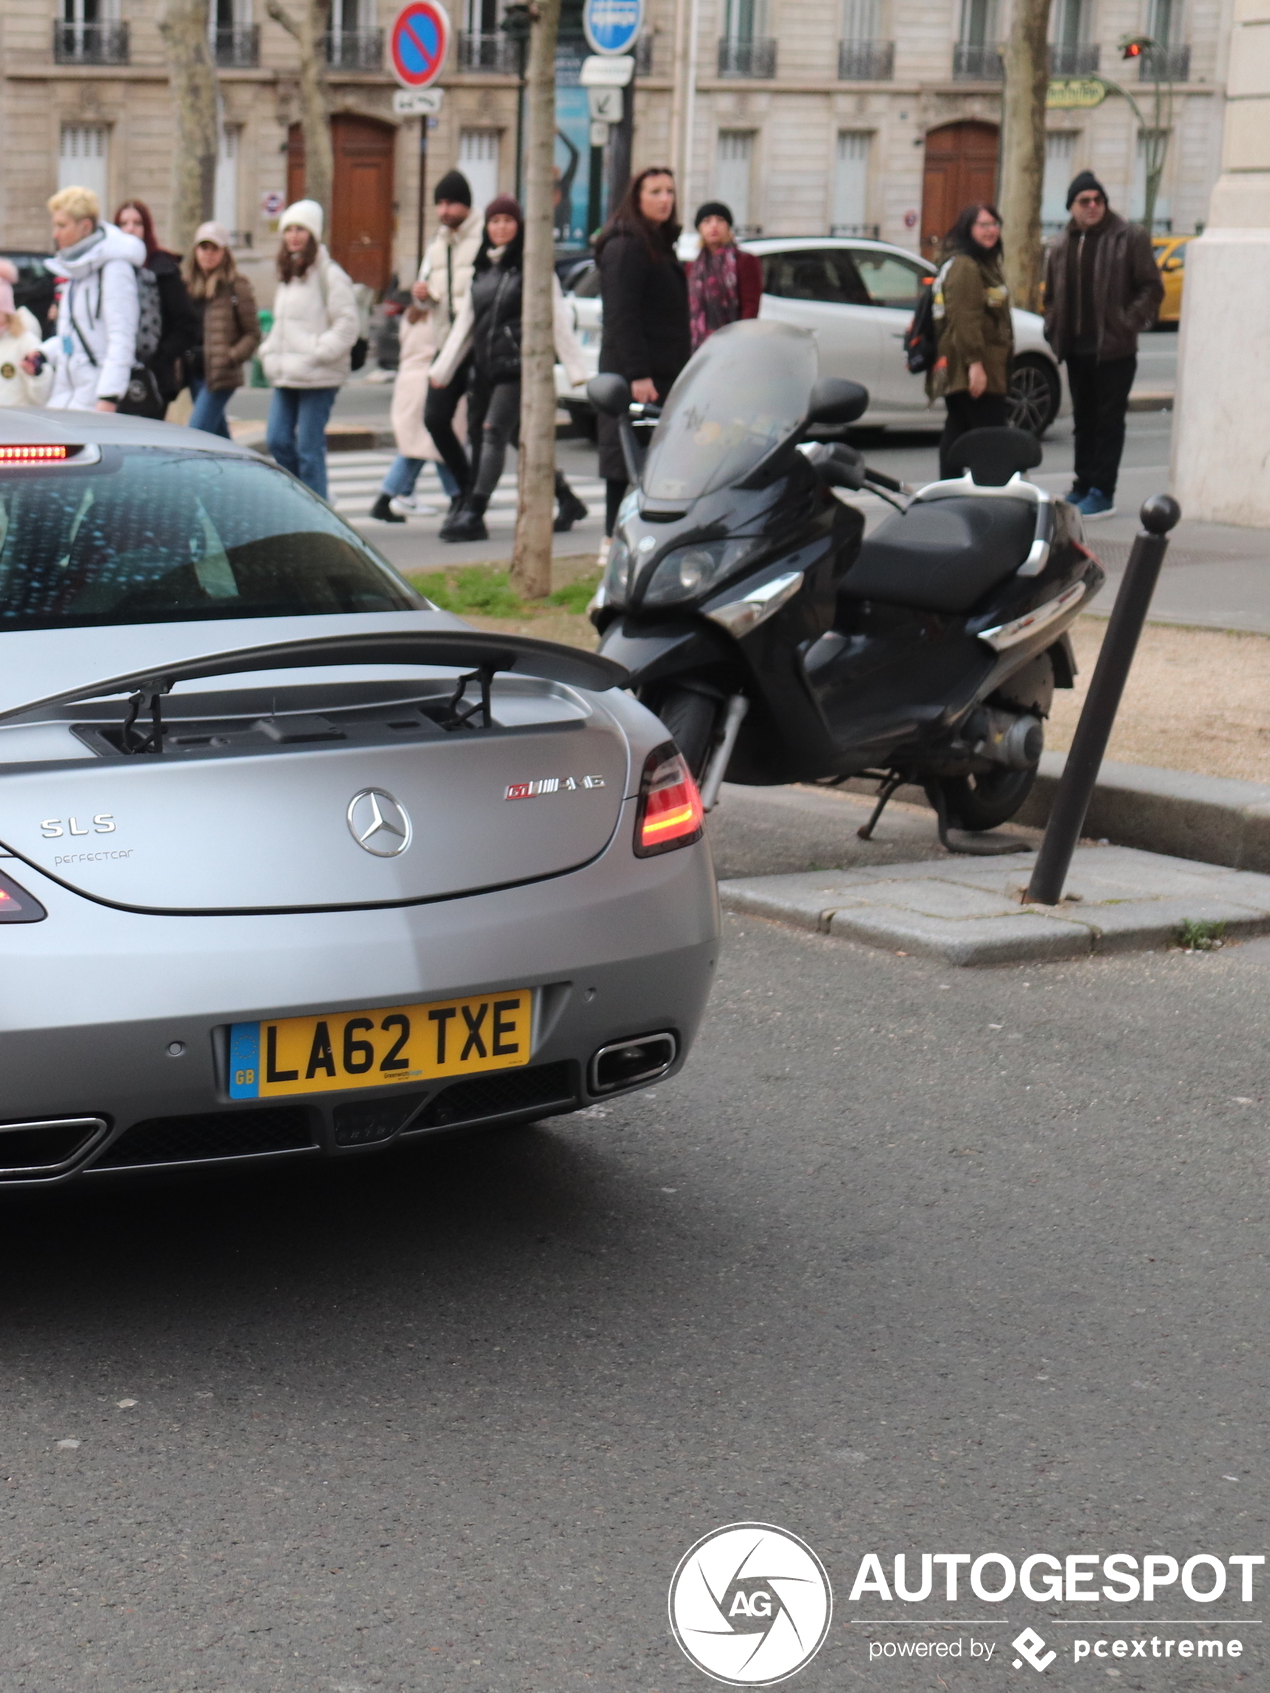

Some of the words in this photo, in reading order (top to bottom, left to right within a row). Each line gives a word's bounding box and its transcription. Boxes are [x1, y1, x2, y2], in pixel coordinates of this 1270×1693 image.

[40, 813, 116, 838] SLS
[266, 1013, 411, 1083] LA62
[428, 998, 521, 1065] TXE
[235, 1069, 255, 1085] GB
